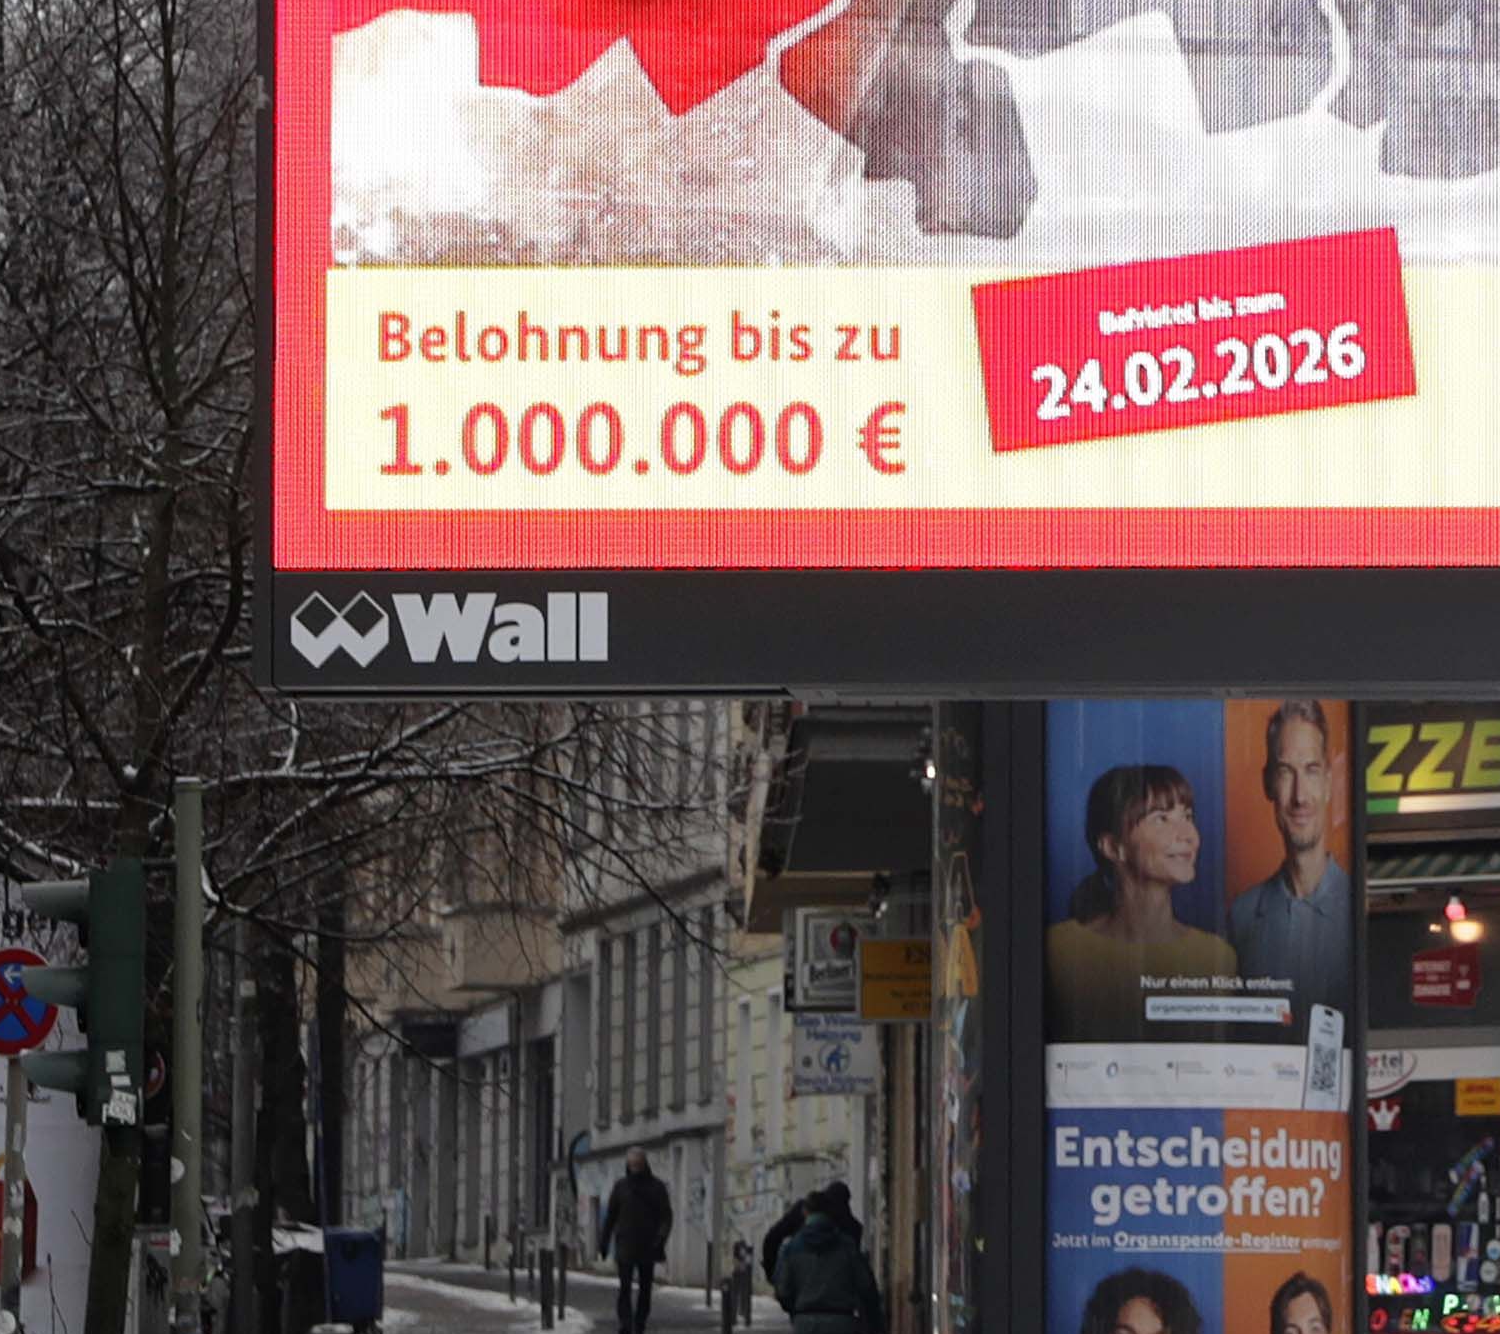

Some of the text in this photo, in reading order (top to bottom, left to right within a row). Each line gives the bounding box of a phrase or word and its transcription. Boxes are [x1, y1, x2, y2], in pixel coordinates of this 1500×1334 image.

[379, 309, 901, 376] Belohnung bis zu
[1032, 321, 1366, 422] 24.02.2026
[381, 401, 907, 476] 1.000.000 €
[392, 591, 609, 664] Wall
[1139, 974, 1166, 989] Nur
[1169, 975, 1209, 990] einen
[1211, 974, 1244, 990] Klick
[1054, 1125, 1342, 1181] Entscheidung
[1090, 1174, 1326, 1226] getroffen?
[1051, 1233, 1089, 1250] Jetzt
[1090, 1233, 1112, 1249] im
[1113, 1230, 1301, 1251] Organspende-Register
